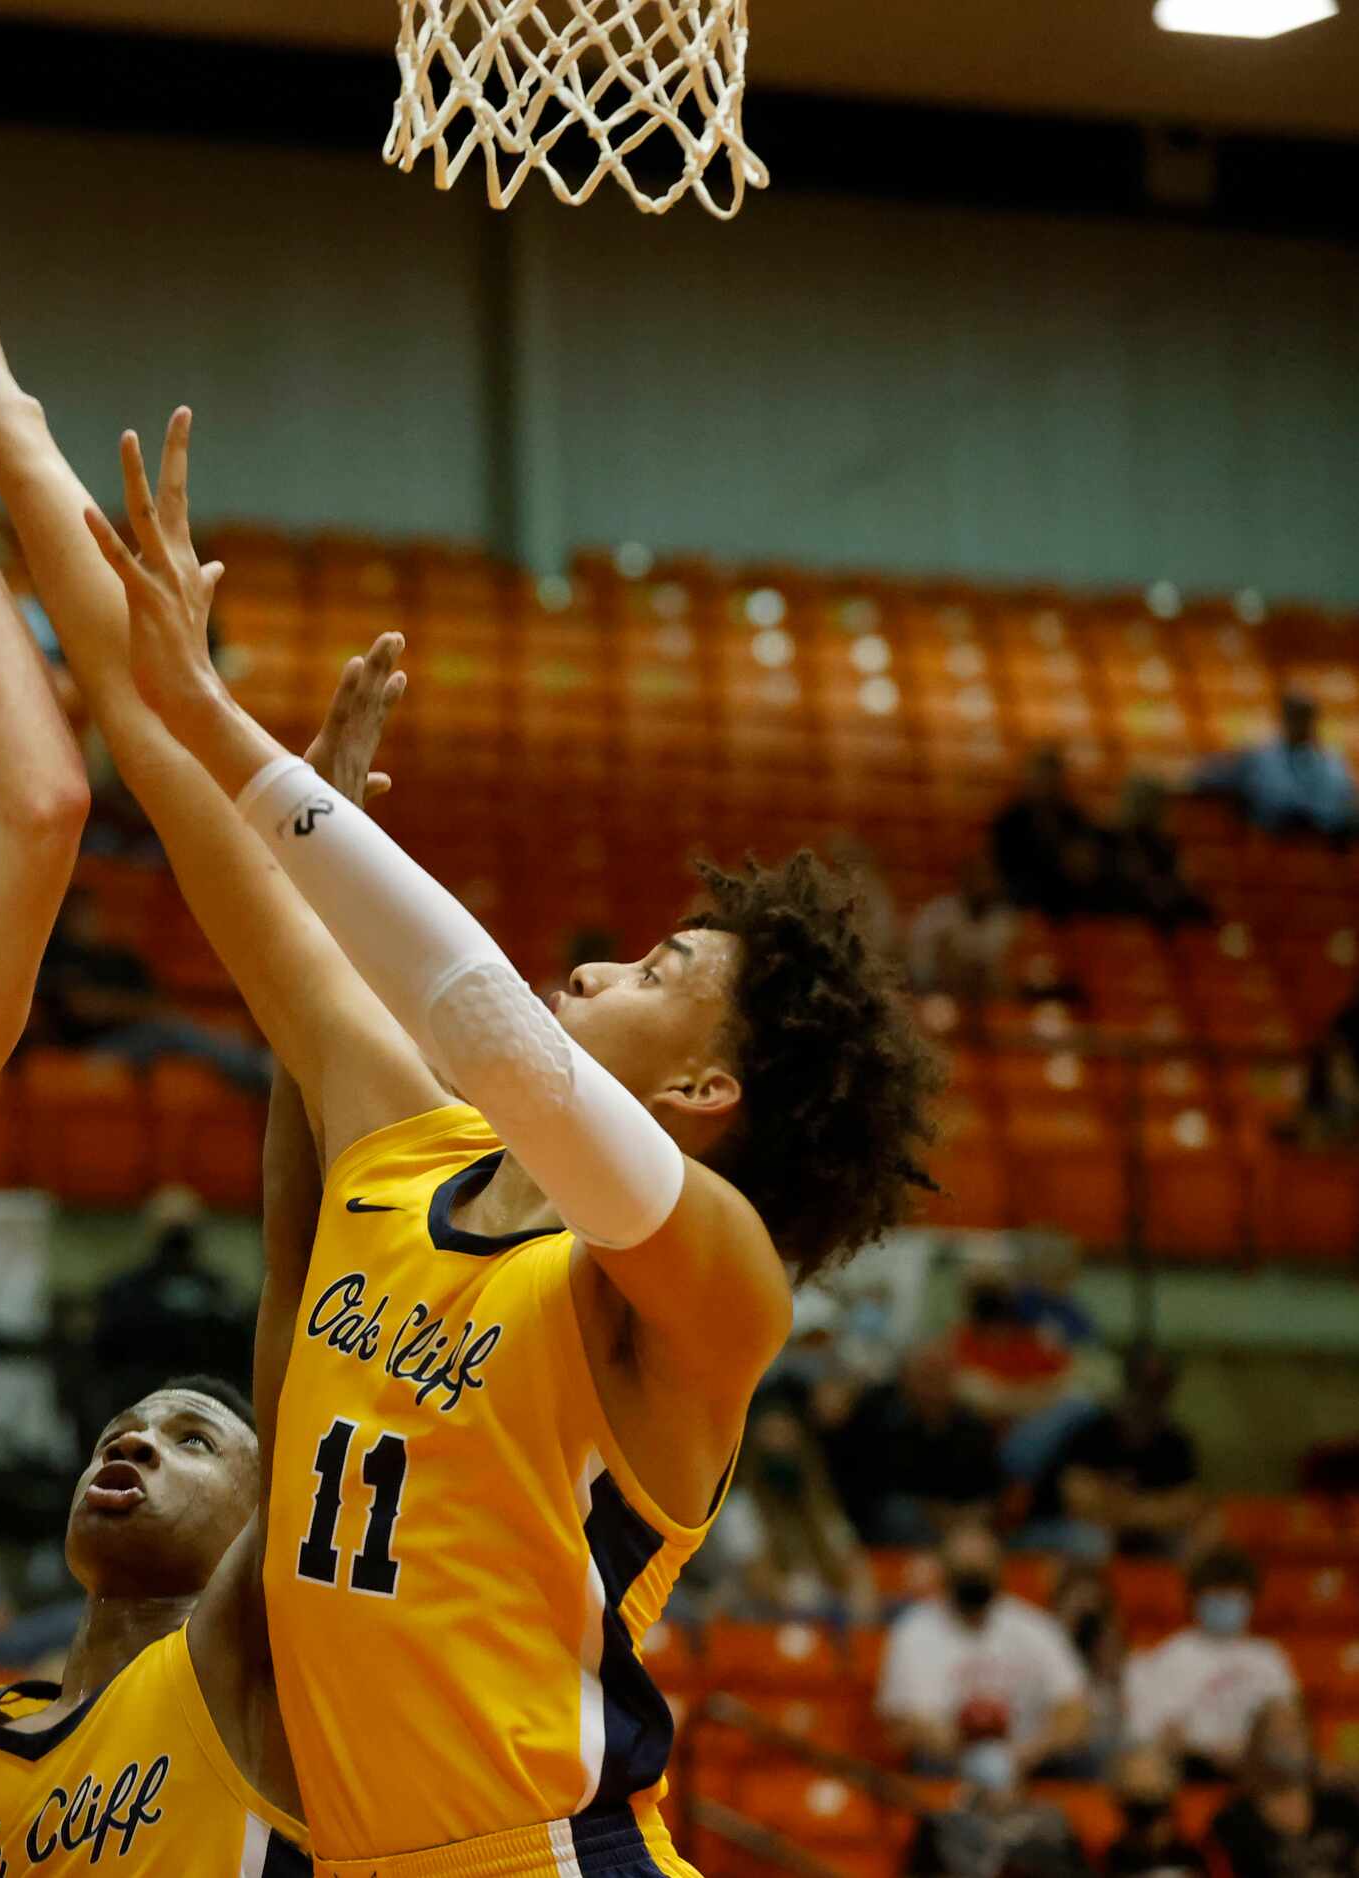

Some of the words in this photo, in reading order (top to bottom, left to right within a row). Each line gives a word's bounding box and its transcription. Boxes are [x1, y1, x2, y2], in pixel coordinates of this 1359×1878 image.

[307, 1272, 391, 1361] Oak
[385, 1301, 502, 1412] Cliff
[295, 1414, 409, 1600] 11
[25, 1753, 170, 1865] Cliff
